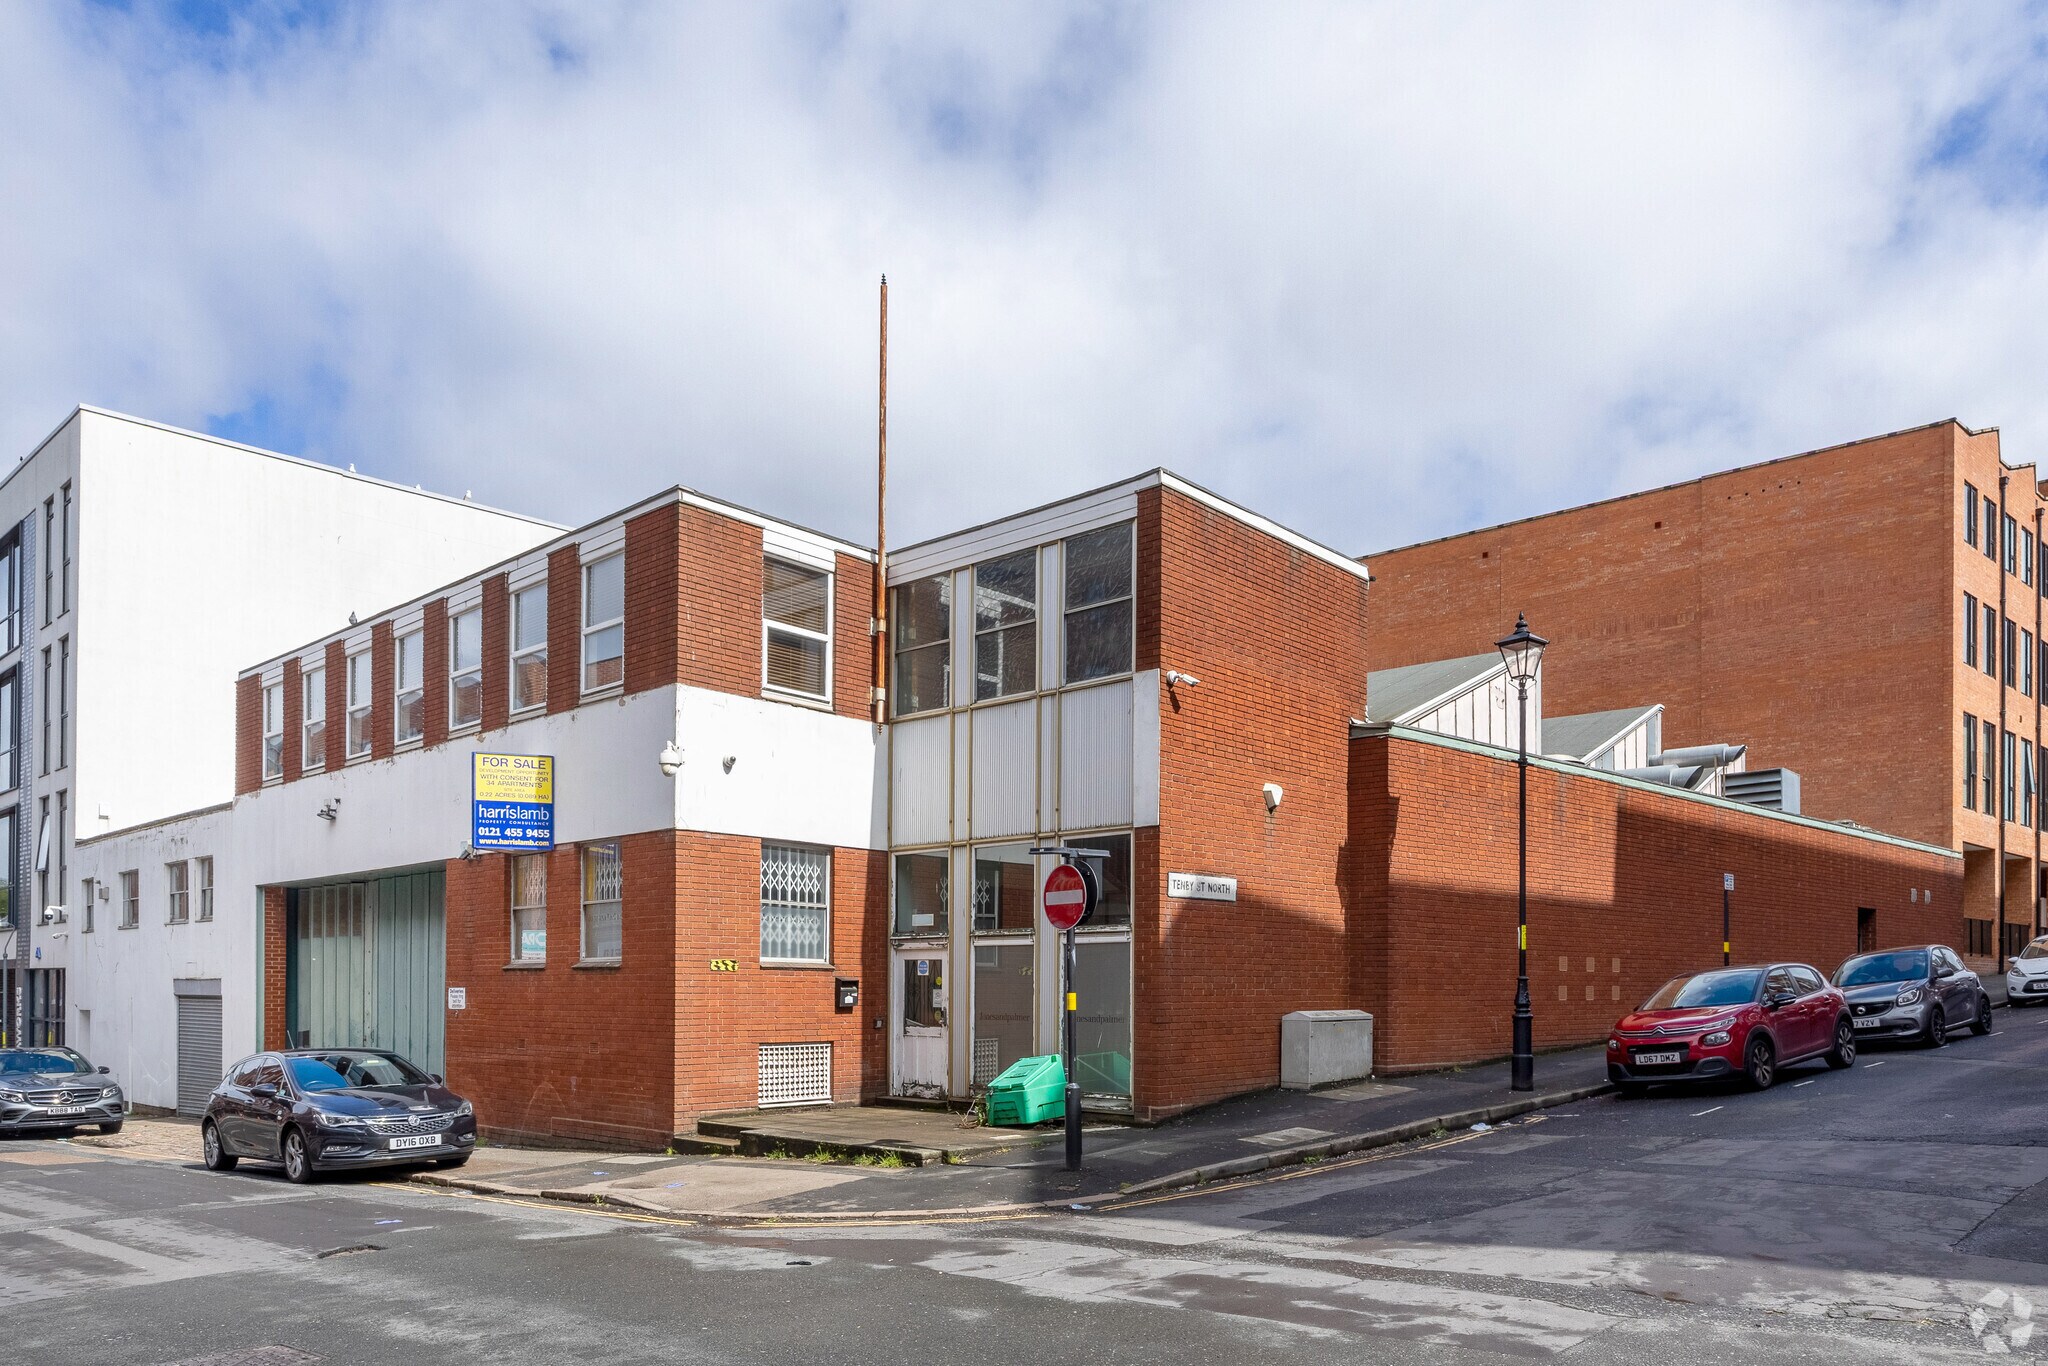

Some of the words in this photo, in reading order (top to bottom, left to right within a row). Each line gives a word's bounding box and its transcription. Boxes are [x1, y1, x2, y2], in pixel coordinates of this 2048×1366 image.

[483, 757, 508, 767] FOR
[514, 758, 546, 769] SALE
[500, 774, 532, 782] CONSENT
[497, 781, 542, 789] APARTMENTS
[479, 804, 549, 820] harrislamb
[478, 827, 501, 836] 0121
[504, 828, 523, 837] 455
[526, 829, 550, 838] 9455
[478, 838, 549, 846] www.harrislamb.com
[1172, 879, 1194, 891] TENBY
[1196, 882, 1205, 892] ST
[1207, 883, 1231, 894] NORTH
[1639, 1055, 1658, 1064] LD67
[1660, 1054, 1676, 1062] DMZ
[396, 1138, 417, 1147] DY16
